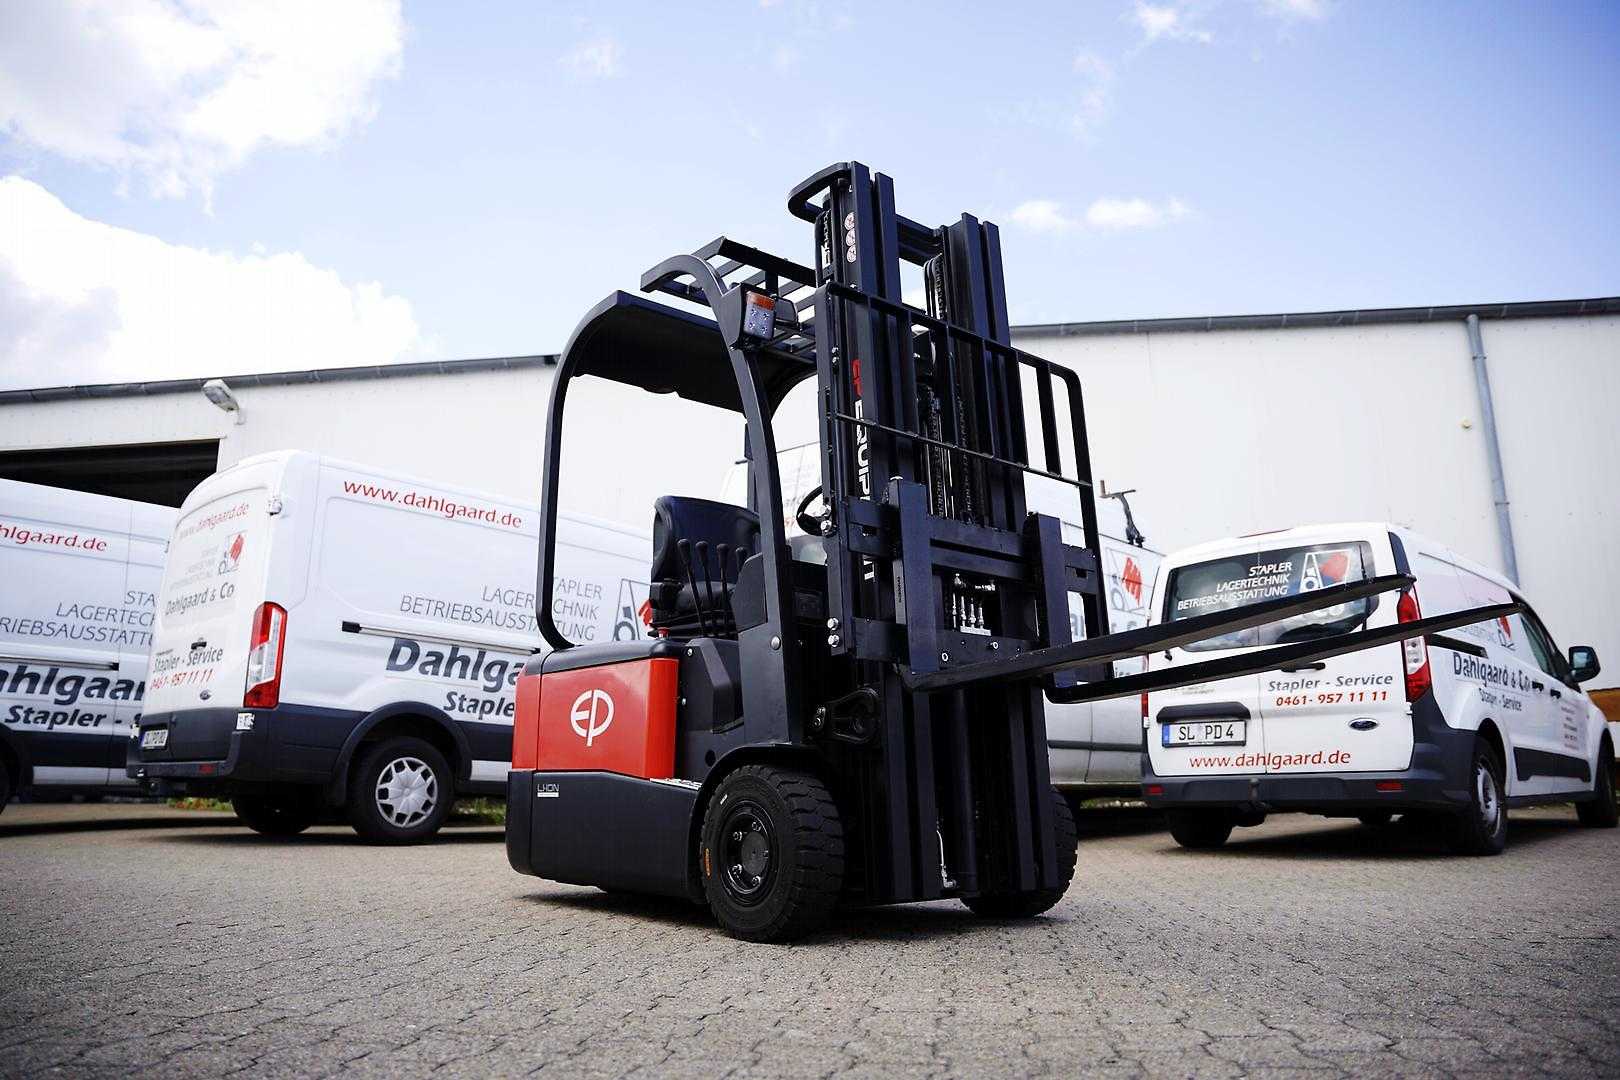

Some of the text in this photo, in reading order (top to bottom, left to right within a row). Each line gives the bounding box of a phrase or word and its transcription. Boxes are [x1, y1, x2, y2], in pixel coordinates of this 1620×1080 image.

[343, 480, 522, 528] www.dahlgaard.de
[1249, 562, 1292, 577] STAPLER
[220, 582, 235, 599] Co
[553, 577, 602, 600] APLER
[1217, 574, 1290, 593] LAGERTECHNIK
[482, 585, 599, 620] LAGERCHNIK
[1178, 586, 1288, 611] BETRIEBSAUSSTATTUNG
[400, 595, 596, 641] BETRIEBSAUSSTTUNG
[187, 647, 224, 666] Service
[1268, 679, 1320, 693] Stapler
[1336, 674, 1393, 687] Service
[1318, 693, 1343, 704] 957
[1350, 692, 1364, 702] 11
[1372, 691, 1387, 701] 11
[5, 705, 107, 730] Stapler
[1178, 724, 1234, 741] SL PD 4
[1189, 750, 1351, 770] www.dahlgaard.de
